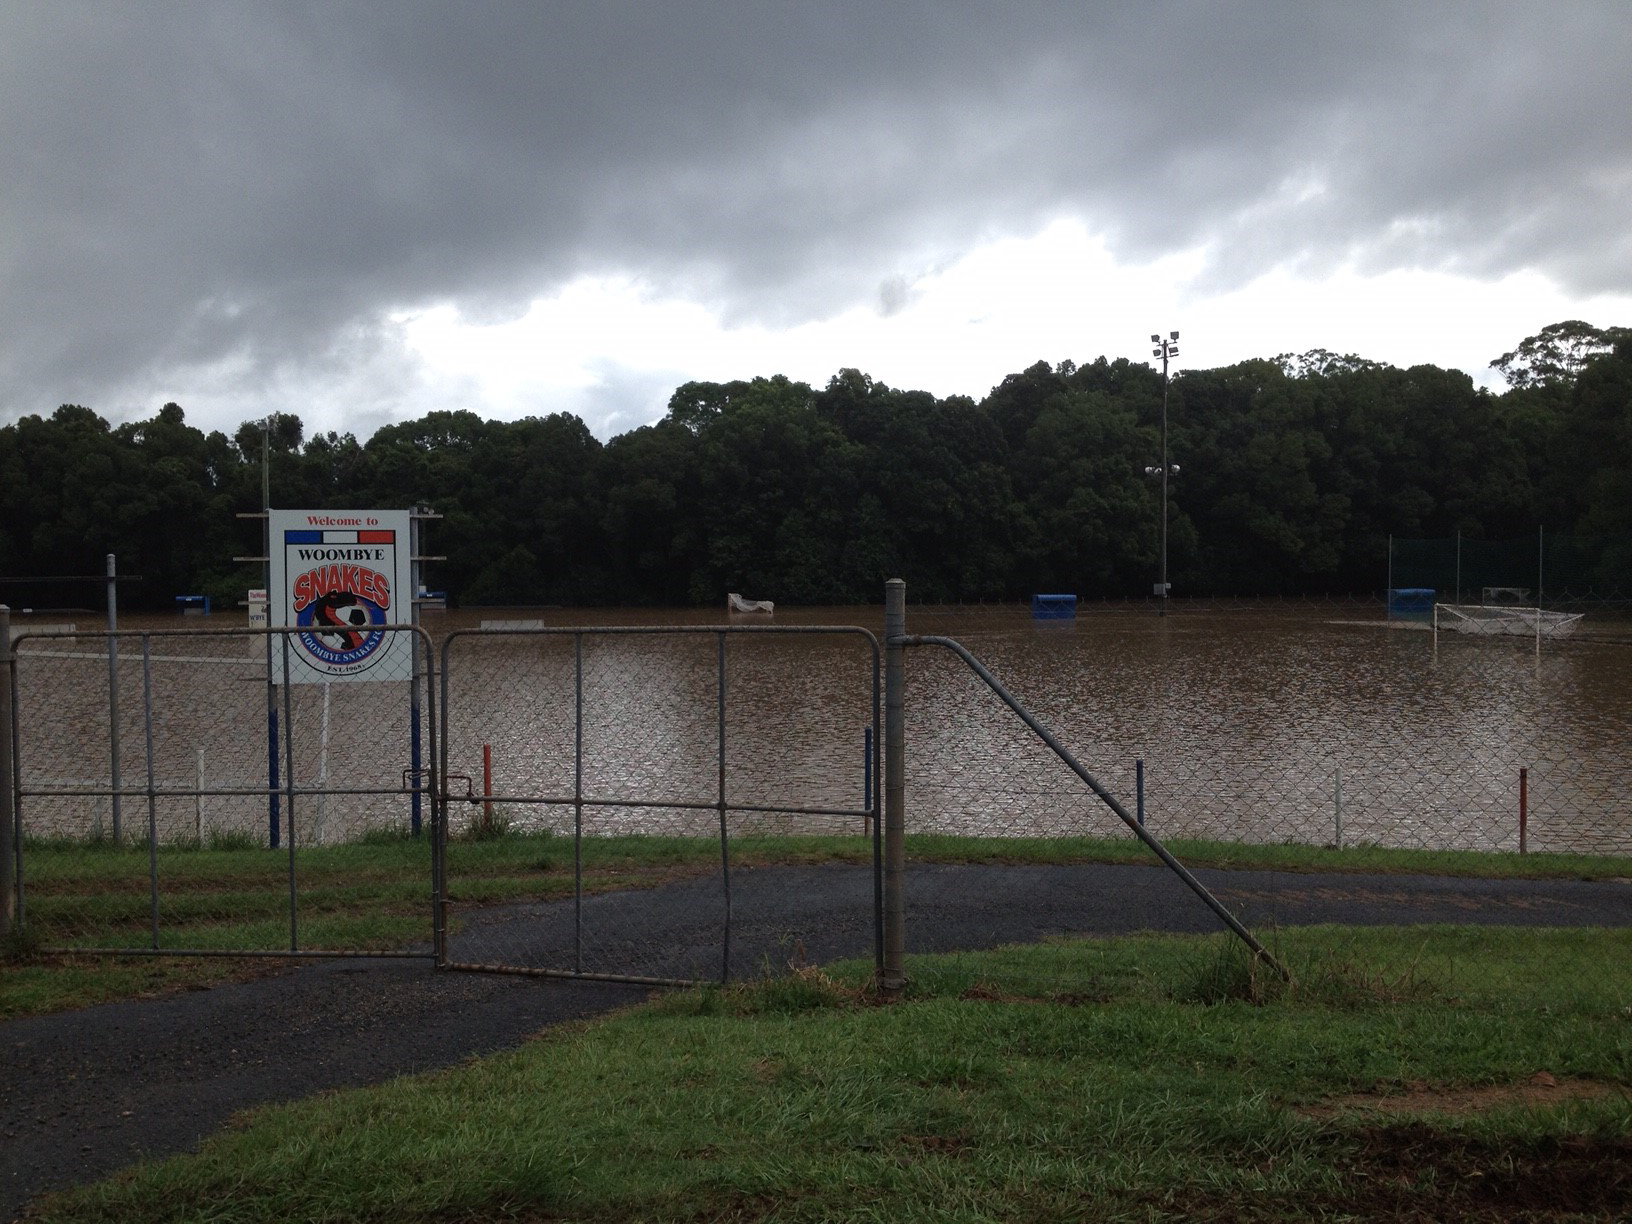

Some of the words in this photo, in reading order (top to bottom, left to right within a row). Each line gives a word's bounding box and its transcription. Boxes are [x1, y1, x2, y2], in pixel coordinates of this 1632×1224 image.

[307, 516, 361, 526] Welcome
[366, 517, 378, 526] to
[298, 549, 385, 561] WOOMBYE
[293, 563, 390, 613] SNAKES
[301, 631, 341, 662] WOOMBYE
[343, 640, 376, 662] SNAKES
